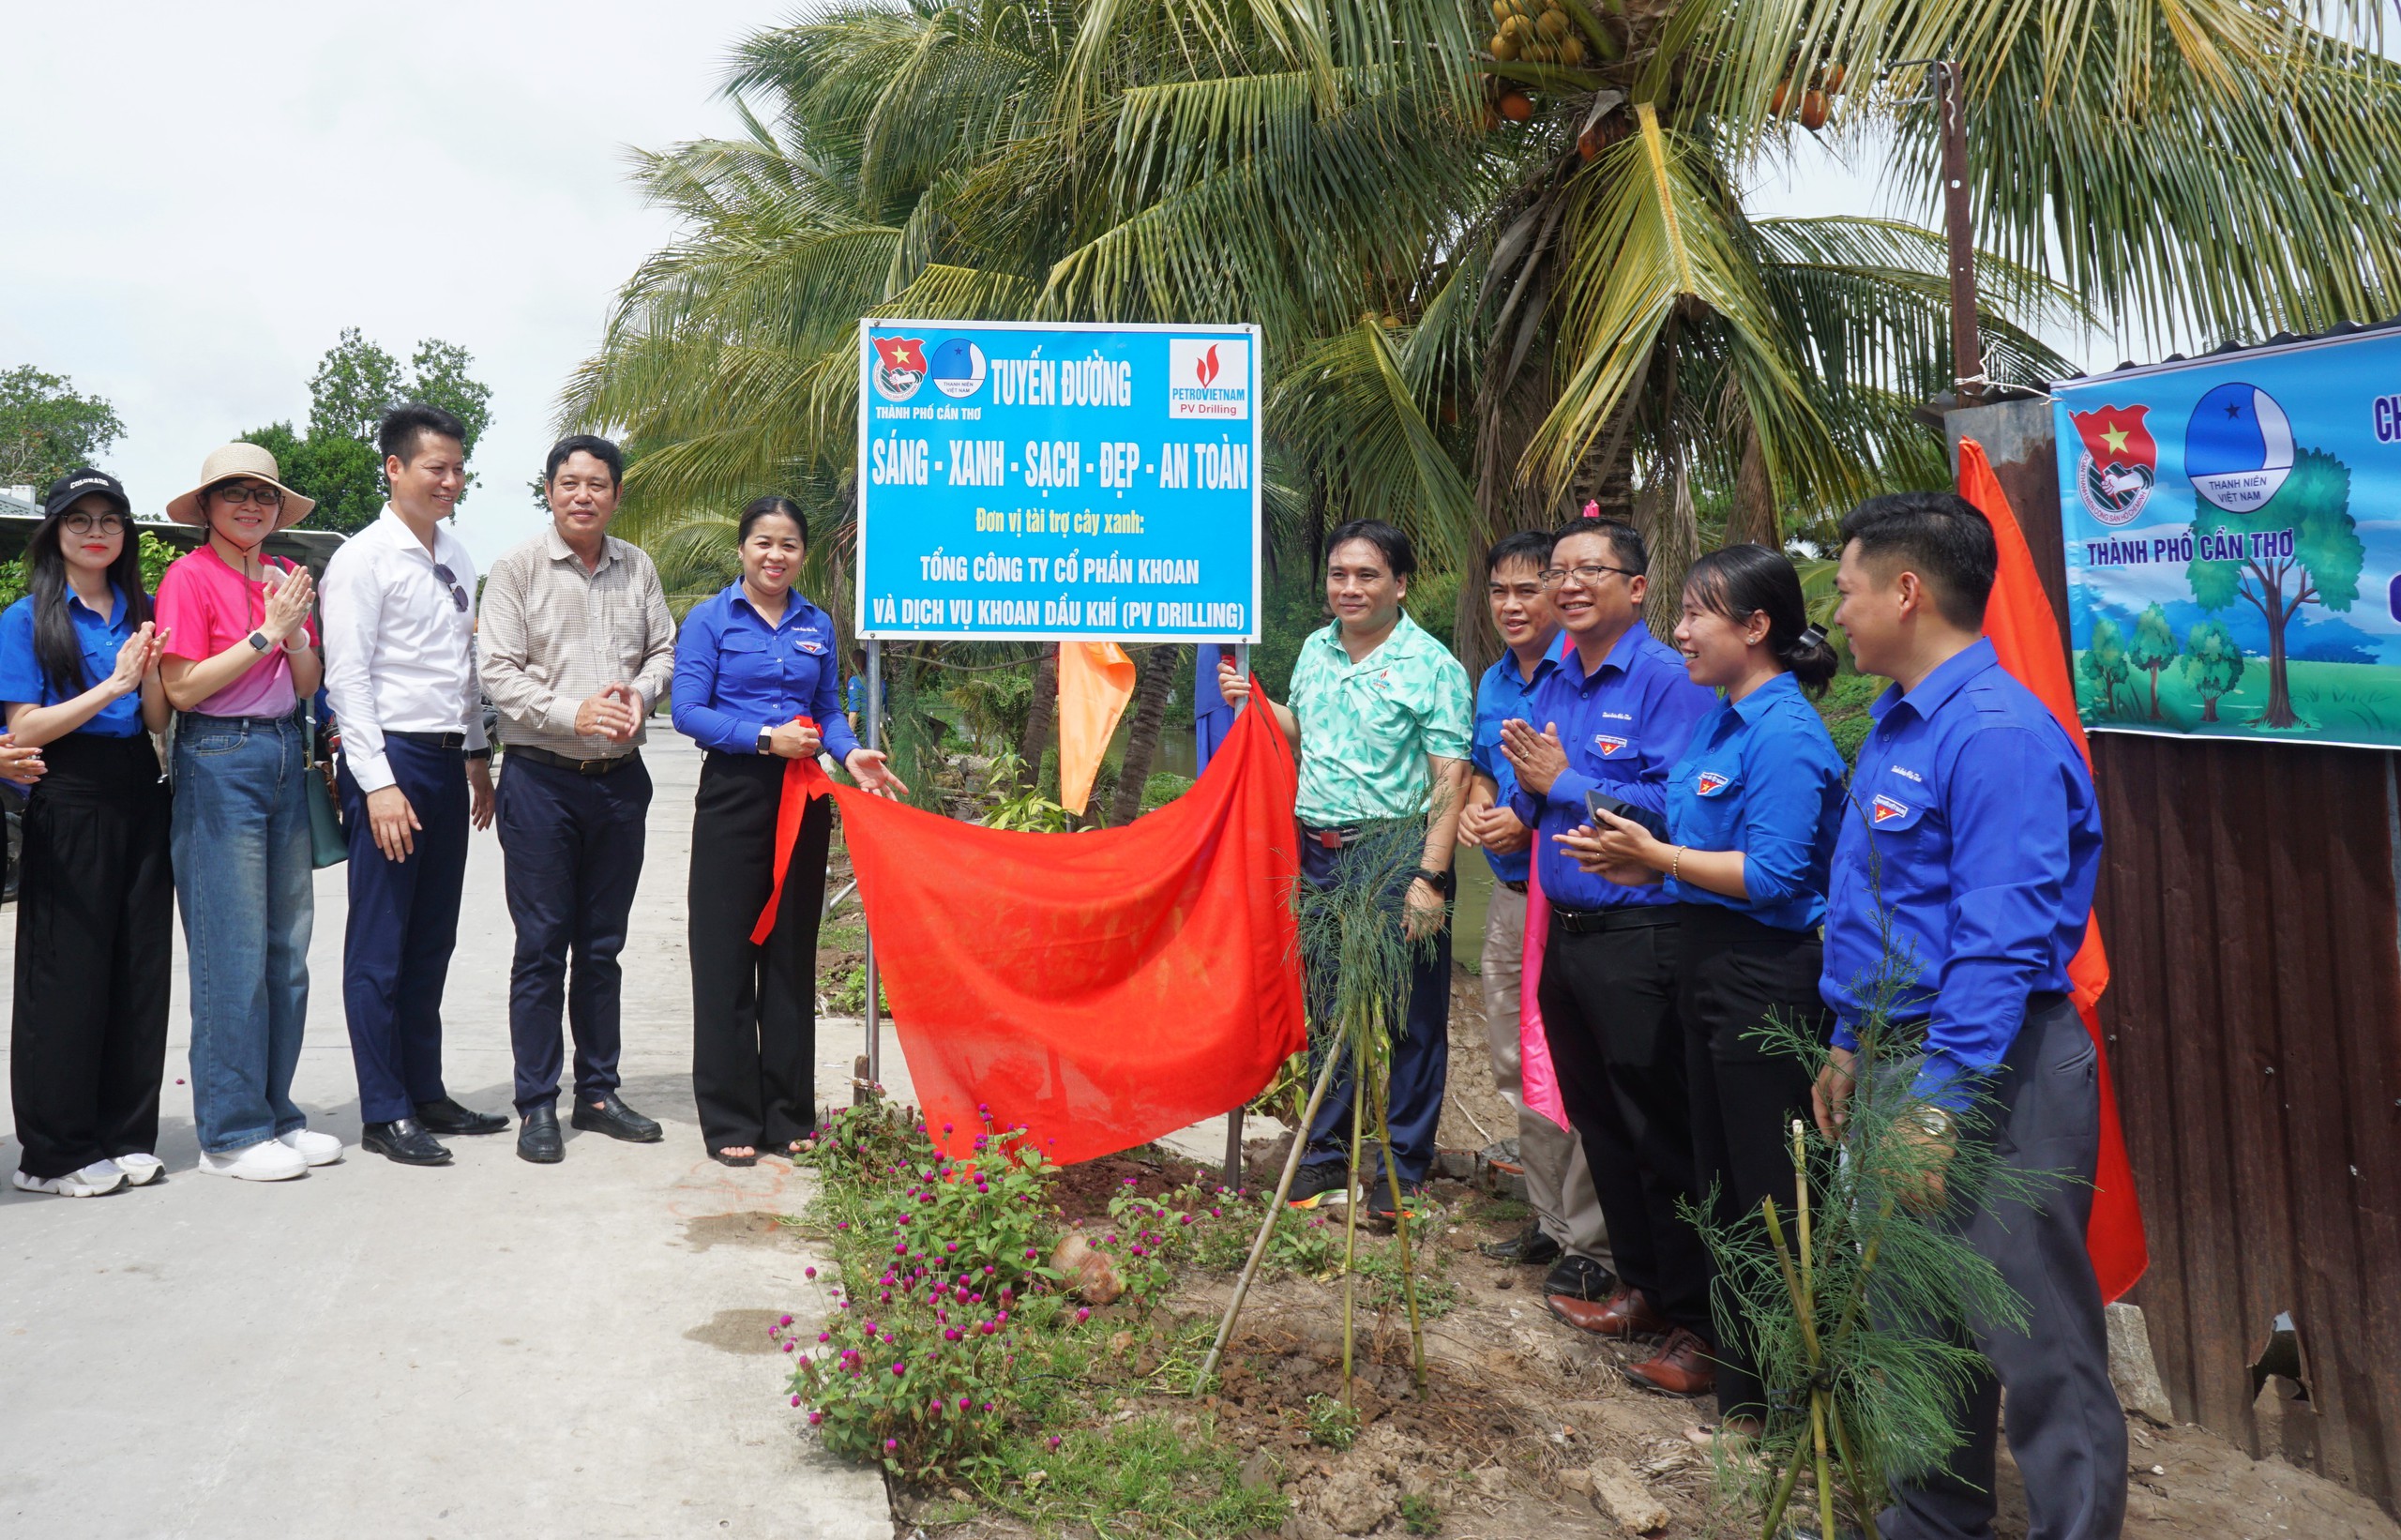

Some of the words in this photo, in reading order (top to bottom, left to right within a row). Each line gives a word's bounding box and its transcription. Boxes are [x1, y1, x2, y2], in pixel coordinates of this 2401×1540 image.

[991, 345, 1055, 406] TUYẾN
[1061, 349, 1131, 407] ĐƯỜNG
[1172, 388, 1245, 400] PETROVIETNAM
[875, 403, 910, 419] THÀNH
[913, 403, 935, 419] PHỐ
[936, 403, 959, 420] CẦN
[961, 407, 982, 420] THƠ
[1181, 404, 1195, 413] PV
[1199, 404, 1237, 416] Drilling
[872, 430, 929, 486] SÁNG
[948, 440, 1004, 486] XANH
[1025, 441, 1080, 497] SẠCH
[1100, 442, 1140, 498] ĐẸP
[1160, 443, 1188, 489] AN
[1195, 433, 1247, 490] TOÀN
[2209, 478, 2242, 490] THANH
[2243, 476, 2267, 488] NIÊN
[2217, 491, 2238, 505] VIỆT
[2240, 491, 2261, 501] NAM
[975, 507, 1004, 532] Đơn
[1008, 508, 1021, 537] vị
[1026, 508, 1045, 533] tài
[1049, 510, 1069, 538] trợ
[1074, 509, 1099, 536] cây
[1104, 510, 1144, 534] xanh:
[2087, 537, 2148, 566] THÀNH
[2154, 528, 2194, 563] PHỐ
[2199, 526, 2243, 561] CẦN
[2251, 528, 2293, 558] THƠ
[920, 547, 967, 581] TỔNG
[974, 551, 1022, 581] CÔNG
[1028, 557, 1049, 581] TY
[1054, 549, 1079, 582] CỔ
[1084, 551, 1132, 583] PHẦN
[1139, 559, 1199, 583] KHOAN
[873, 594, 897, 623] VÀ
[901, 600, 944, 629] DỊCH
[949, 600, 973, 630] VỤ
[978, 600, 1039, 625] KHOAN
[1045, 593, 1080, 626] DẦU
[1087, 596, 1116, 626] KHÍ
[1123, 602, 1152, 628] (PV
[1157, 602, 1244, 630] DRILLING)
